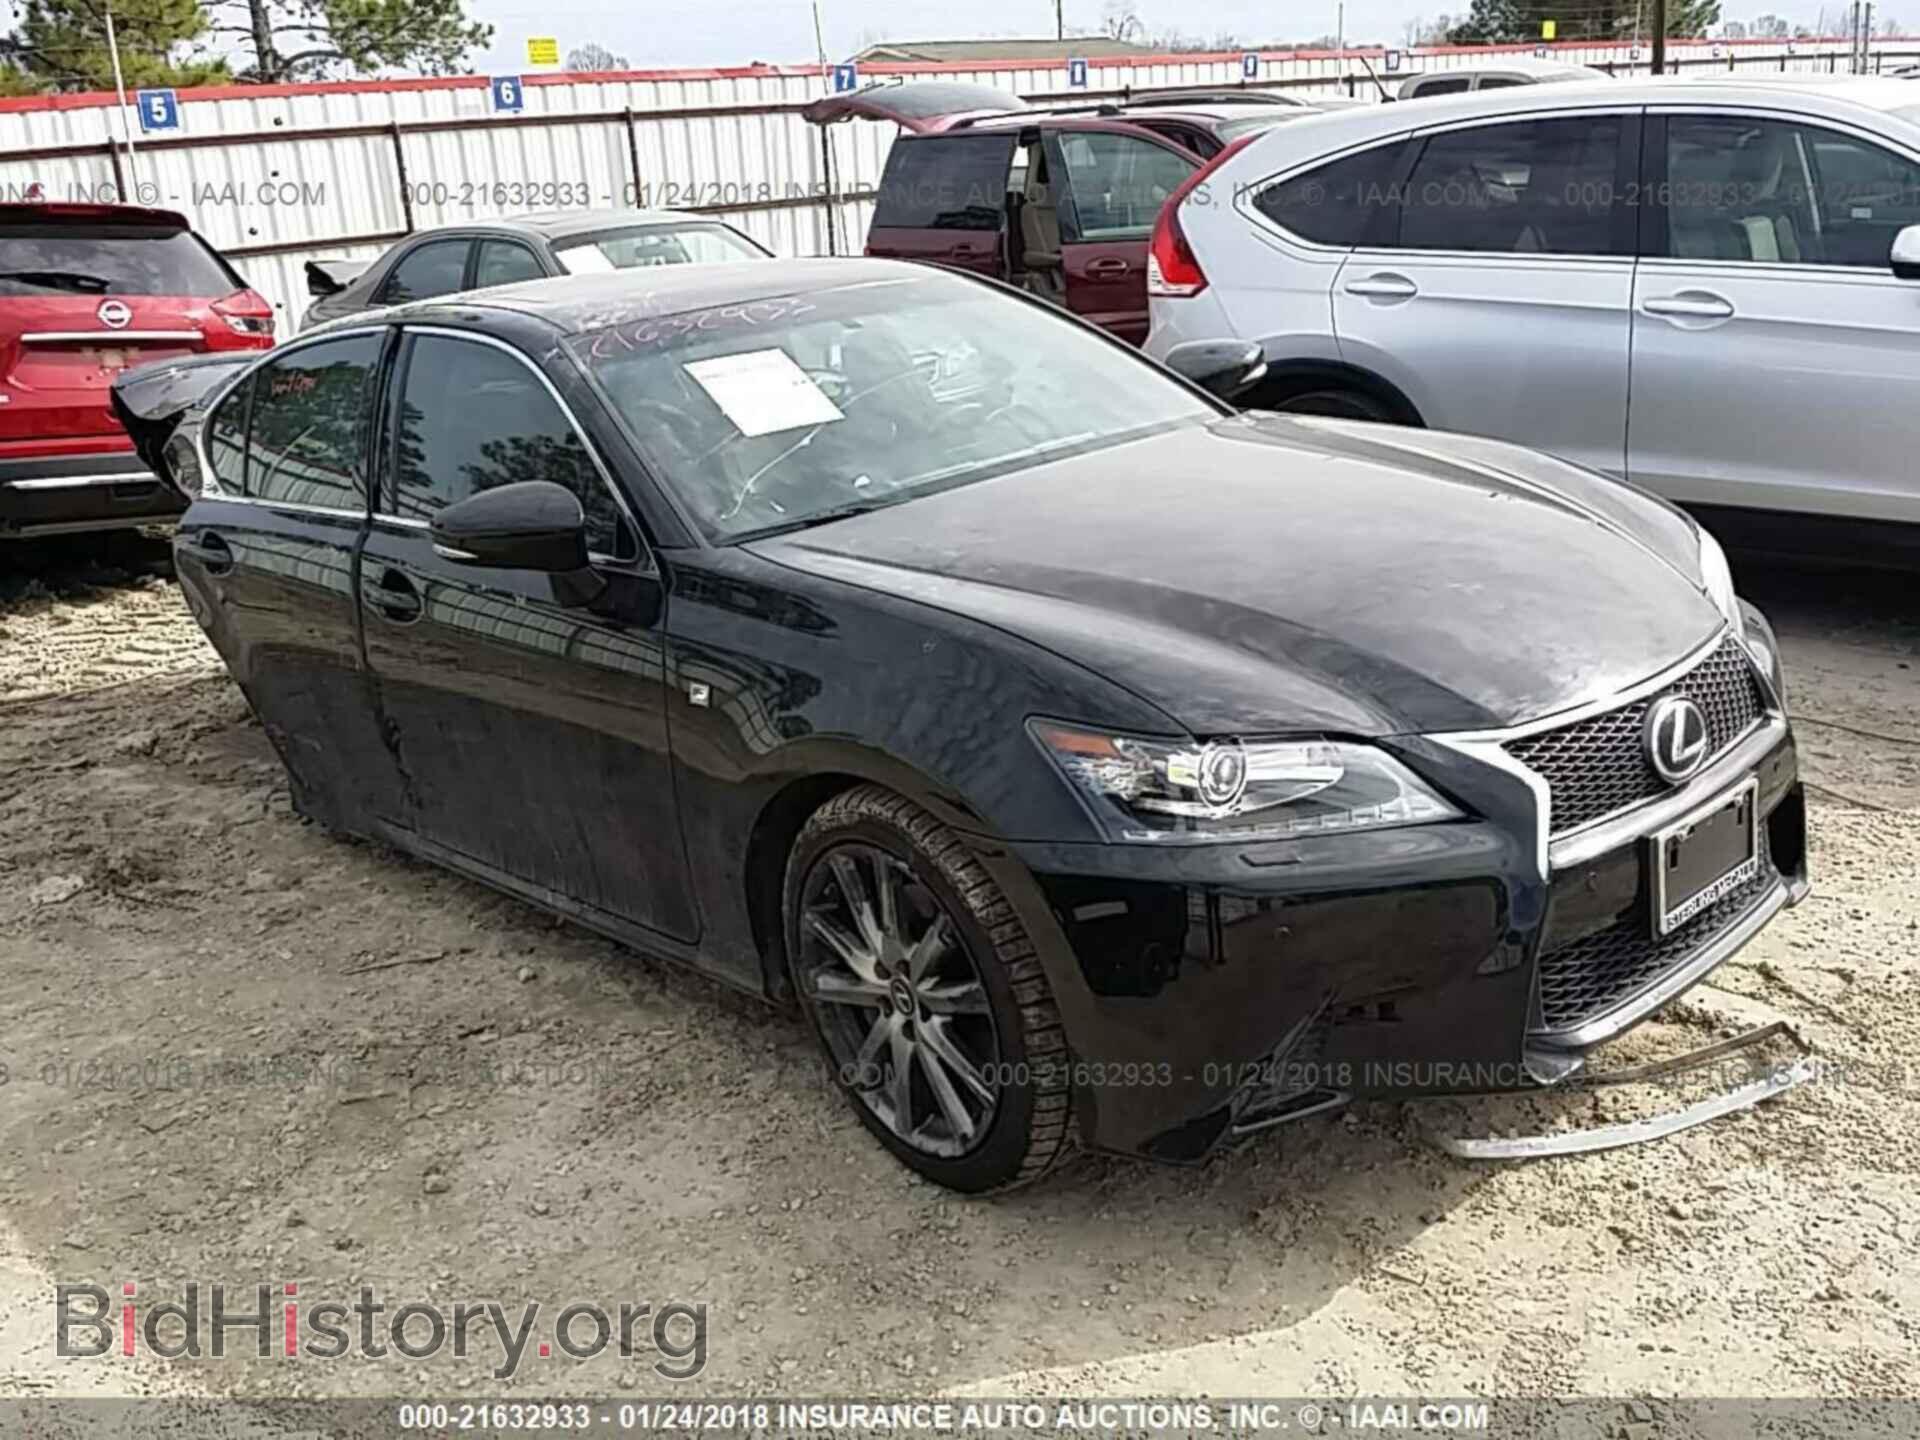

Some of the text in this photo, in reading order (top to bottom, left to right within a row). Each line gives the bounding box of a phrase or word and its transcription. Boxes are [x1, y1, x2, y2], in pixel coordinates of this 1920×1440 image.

[840, 70, 850, 88] 7
[501, 81, 515, 104] 6
[151, 96, 168, 122] 5
